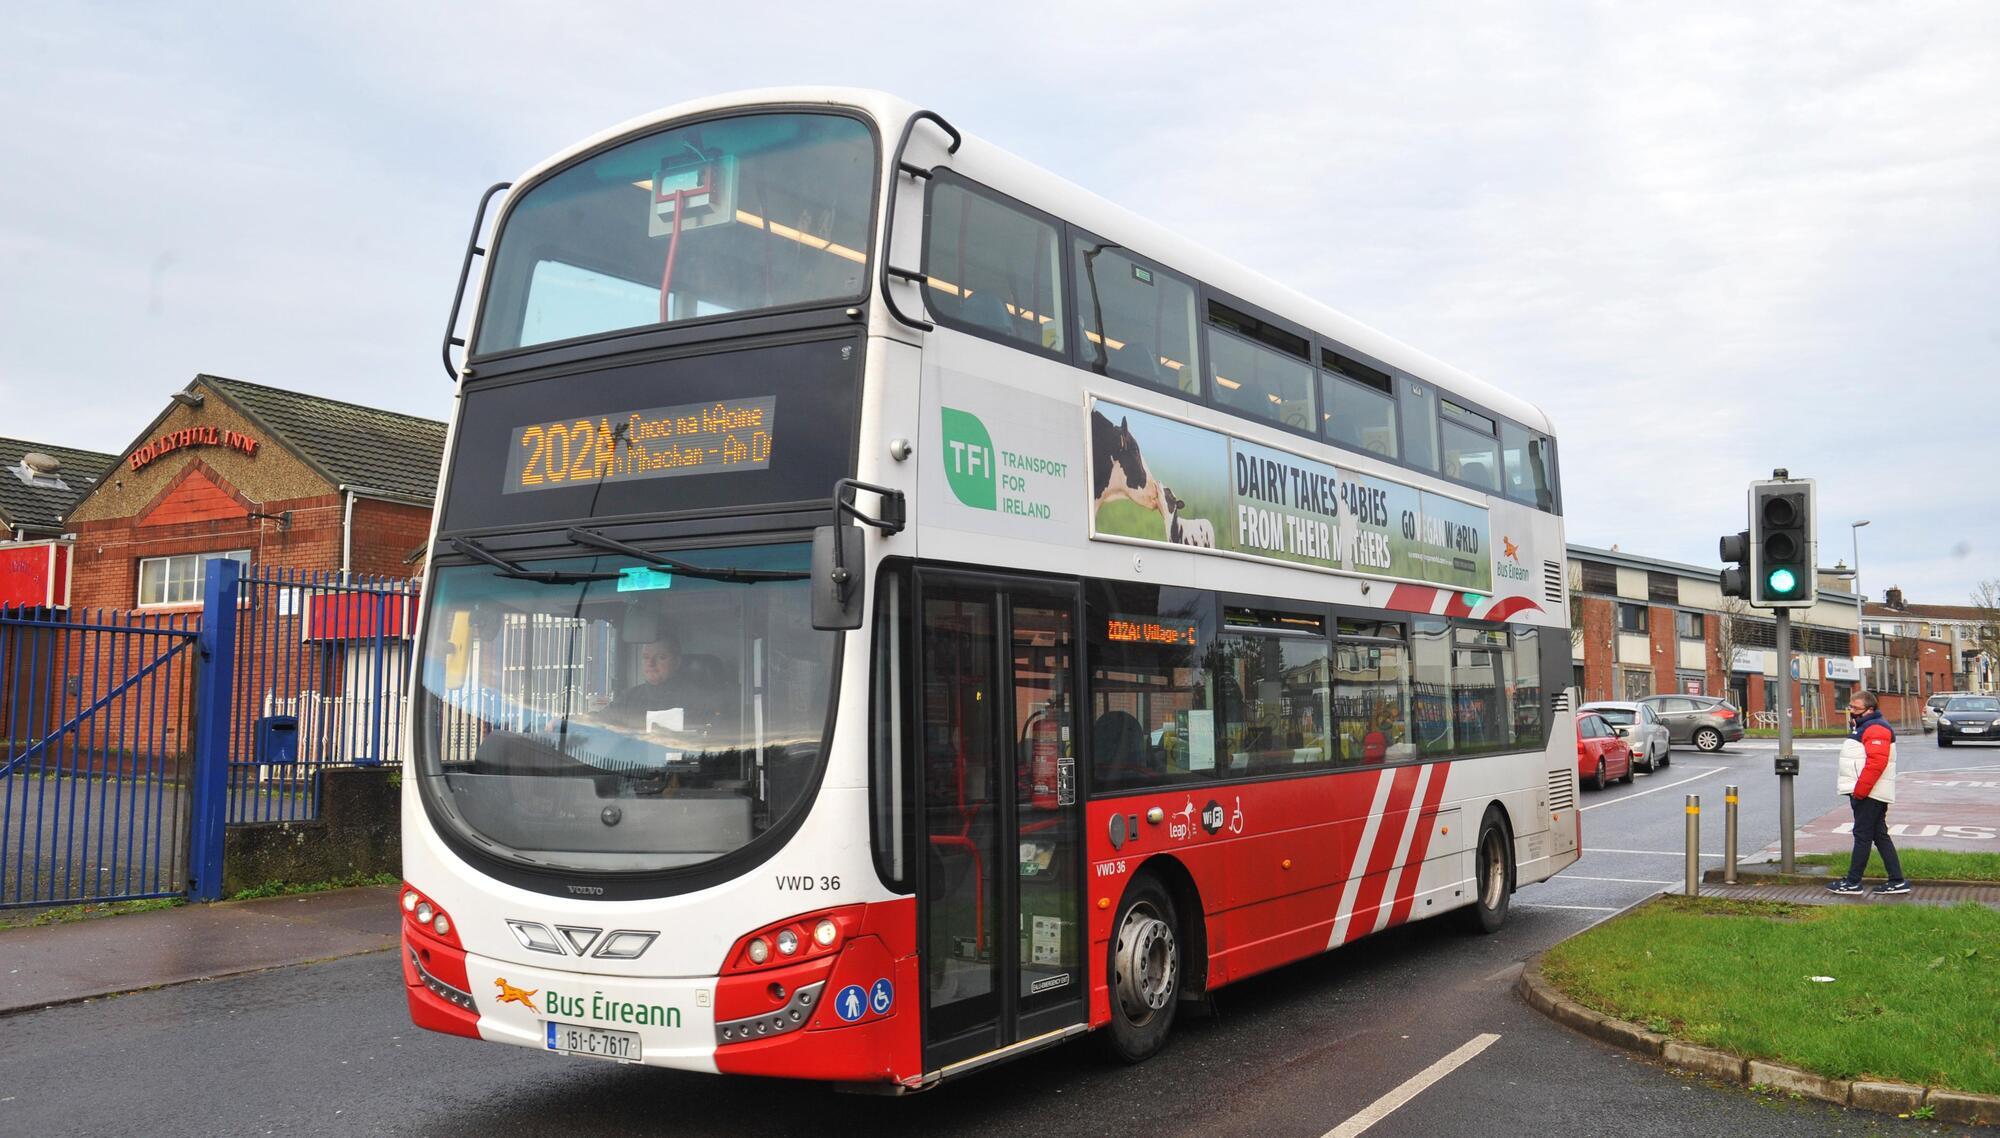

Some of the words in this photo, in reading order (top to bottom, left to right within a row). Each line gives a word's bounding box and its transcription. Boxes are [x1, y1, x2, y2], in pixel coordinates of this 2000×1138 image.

[629, 413, 673, 443] Cnoc
[676, 416, 699, 434] na
[127, 426, 218, 472] HOLLYHILL
[224, 429, 258, 454] INN
[521, 416, 615, 486] 202A
[627, 443, 704, 475] Mhachan
[724, 433, 748, 464] An
[949, 440, 990, 479] TFI
[1002, 451, 1067, 479] TRANSPORT
[1002, 474, 1026, 492] FOR
[1236, 452, 1287, 506] DAIRY
[1290, 466, 1338, 518] TAKES
[1002, 497, 1051, 519] IRELAND
[1238, 503, 1285, 552] FROM
[1286, 514, 1331, 560] THEIR
[1332, 524, 1391, 569] MTHERS
[1169, 822, 1187, 840] leap
[775, 875, 815, 891] VWD
[820, 875, 841, 891] 36
[1096, 862, 1116, 877] VWD
[1116, 860, 1127, 874] 36
[567, 885, 604, 896] VOLVO
[546, 990, 585, 1018] Bus
[592, 990, 681, 1028] Éireann
[566, 1030, 630, 1057] 151-C-7617
